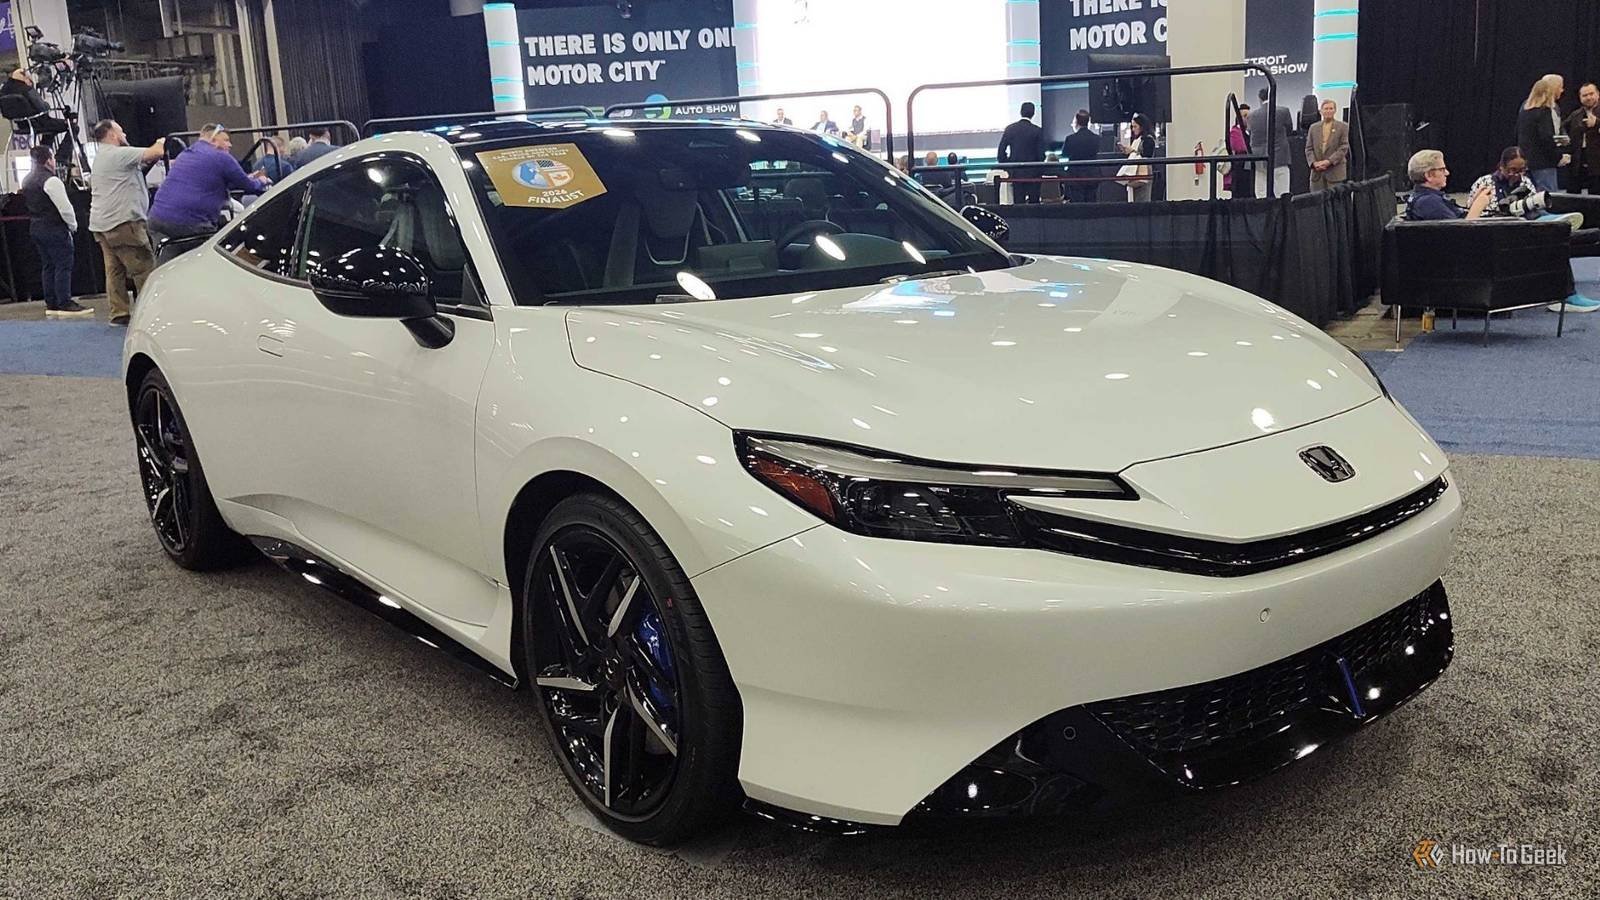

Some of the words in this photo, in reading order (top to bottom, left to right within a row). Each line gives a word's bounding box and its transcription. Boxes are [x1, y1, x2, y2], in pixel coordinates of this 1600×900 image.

[524, 33, 597, 57] THERE
[603, 32, 626, 54] IS
[632, 29, 692, 52] ONLY
[1069, 20, 1148, 51] MOTOR
[527, 62, 604, 86] MOTOR
[1270, 63, 1308, 75] SHOW
[675, 106, 704, 116] AUTO
[705, 104, 737, 114] SHOW
[527, 190, 585, 204] FINALIST
